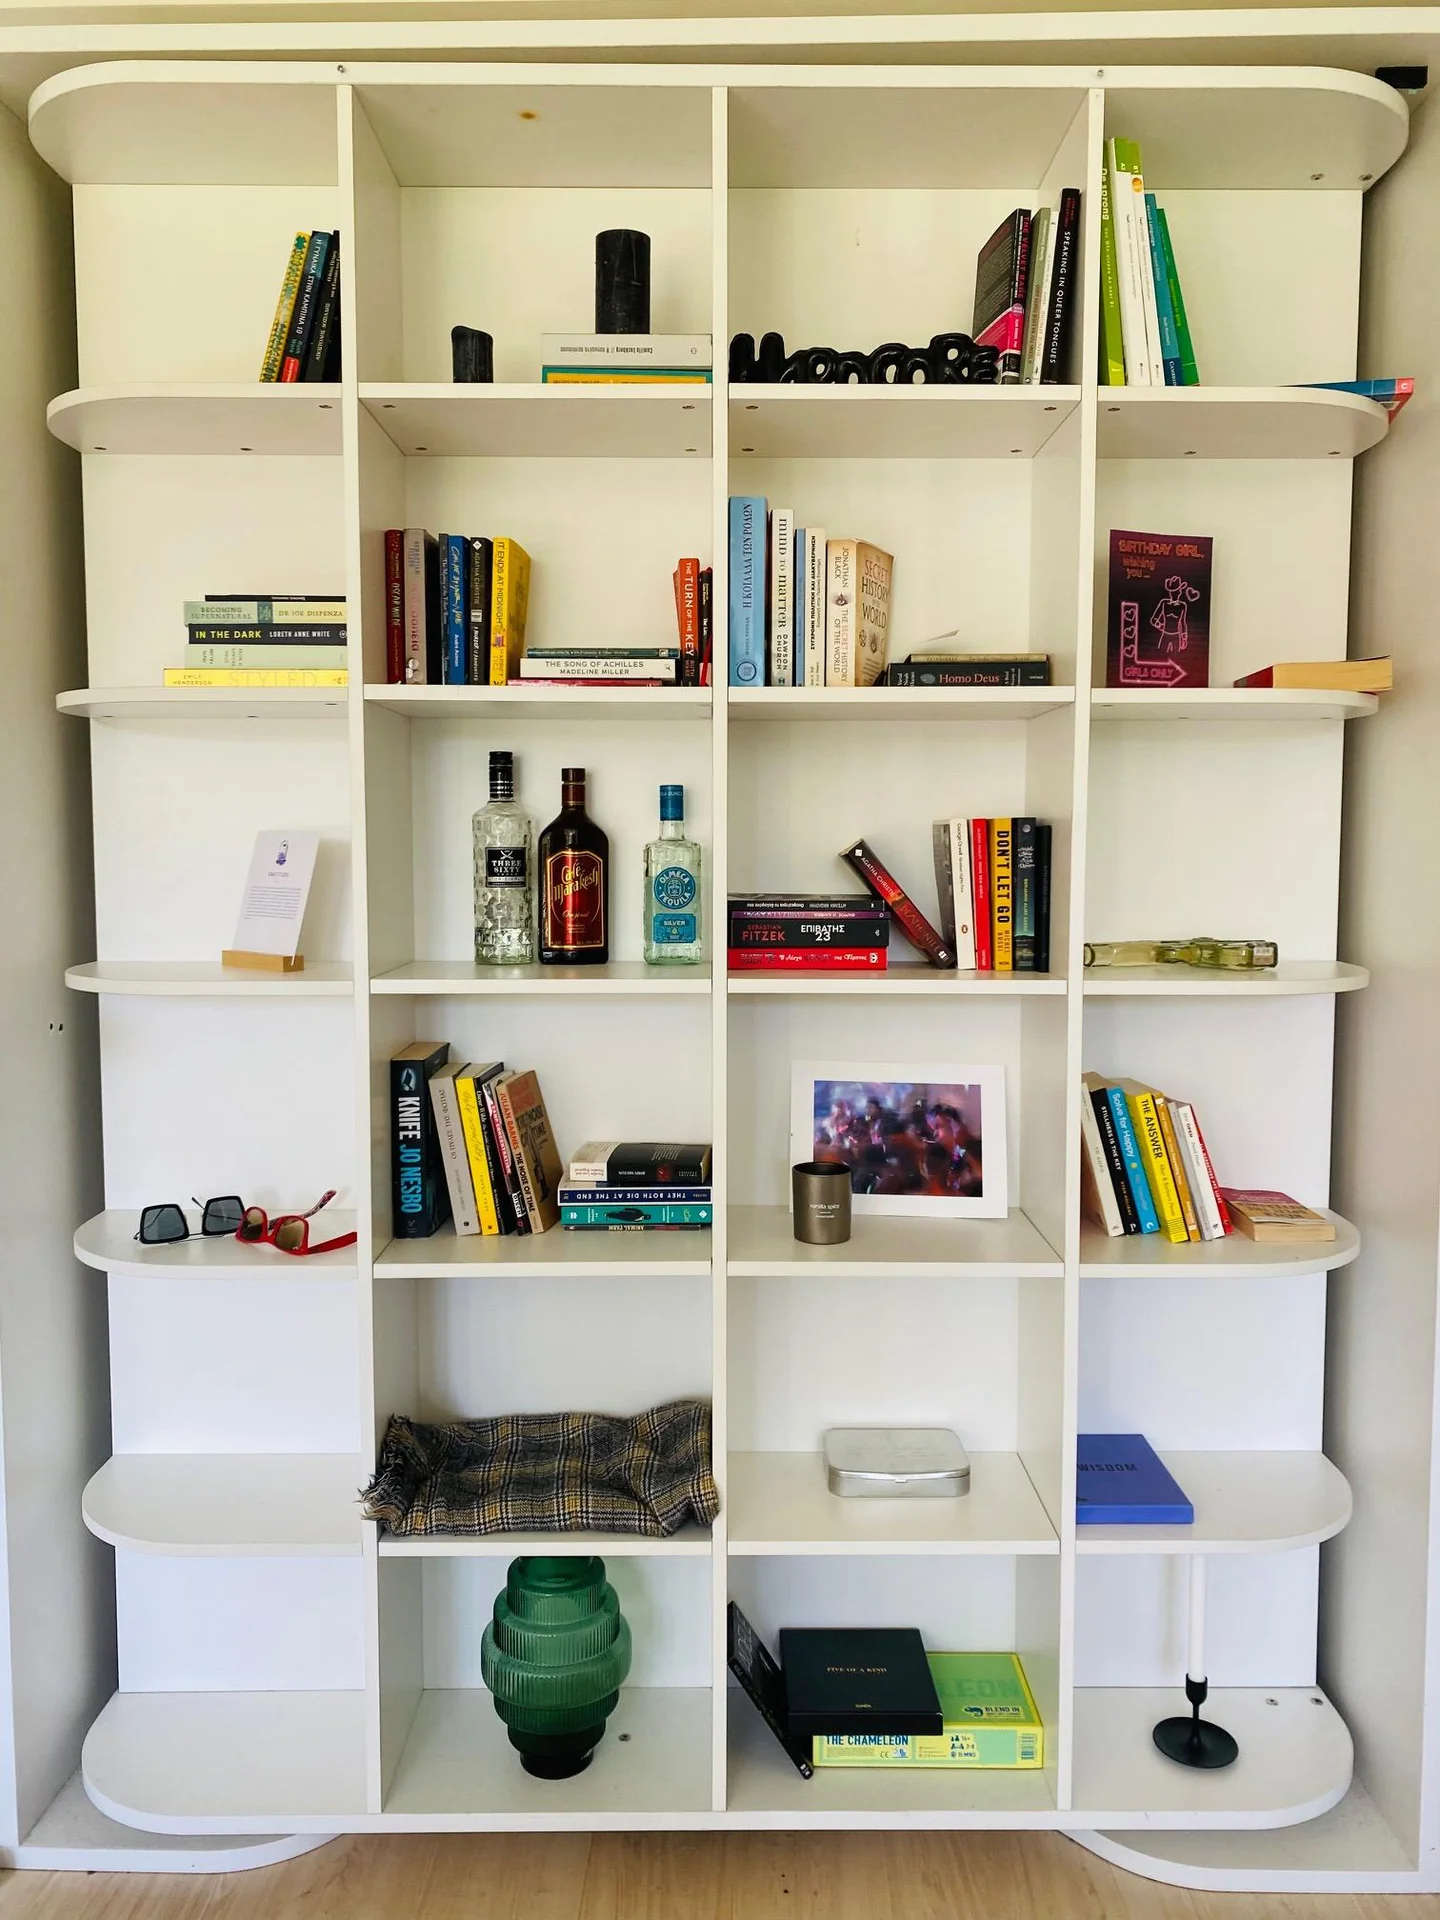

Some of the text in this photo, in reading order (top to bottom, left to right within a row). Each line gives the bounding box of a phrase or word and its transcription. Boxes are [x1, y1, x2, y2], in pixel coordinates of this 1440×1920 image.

[309, 245, 321, 274] ΓΥΝΑΙΚΑ
[1019, 237, 1028, 271] VELVET
[305, 275, 314, 292] ΣΤΗΝ
[297, 293, 310, 325] ΚΑΜΠΙΝΑ
[1049, 230, 1072, 364] SPEAKING IN QUEER TONGUES
[744, 503, 752, 534] ΡΟΔΩΝ
[744, 536, 752, 555] ΤΩΝ
[1118, 540, 1171, 555] BIRTHDAY
[495, 541, 505, 628] IT ENDS AT MIDNIGHT
[744, 558, 752, 598] ΚΟΙΛΑΔΑ
[861, 577, 890, 603] HISTORY
[391, 583, 401, 605] OSCAR
[683, 576, 695, 607] TURN
[686, 609, 691, 618] OF
[834, 618, 840, 627] OF
[862, 603, 887, 629] WORLD
[195, 631, 206, 639] IN
[234, 630, 261, 638] DARK
[685, 634, 693, 656] KEY
[229, 672, 318, 686] STYLED
[939, 674, 999, 683] Homo Deus
[1125, 667, 1173, 678] GIRLS ONLY
[491, 859, 521, 867] THREE
[658, 870, 689, 884] OLMECA
[861, 856, 895, 897] AGATHA CHRISTIE
[997, 830, 1010, 922] DON'T LET GO
[658, 891, 691, 906] TEQUILA
[742, 931, 785, 940] FITZEK
[815, 931, 830, 941] 23
[923, 932, 940, 951] NILE
[398, 1096, 421, 1139] KNIFE
[499, 1092, 521, 1150] JULIAN BARNES
[1112, 1093, 1135, 1157] Solve for Happy
[1141, 1099, 1162, 1158] THE ANSWER
[1101, 1106, 1113, 1137] STILLNESS
[1110, 1145, 1118, 1157] THE
[400, 1143, 422, 1212] JO NESBO
[515, 1152, 535, 1211] THE NOISE OF TIME
[1077, 1463, 1138, 1472] WISDOM
[826, 1734, 908, 1745] THE CHAMELEON
